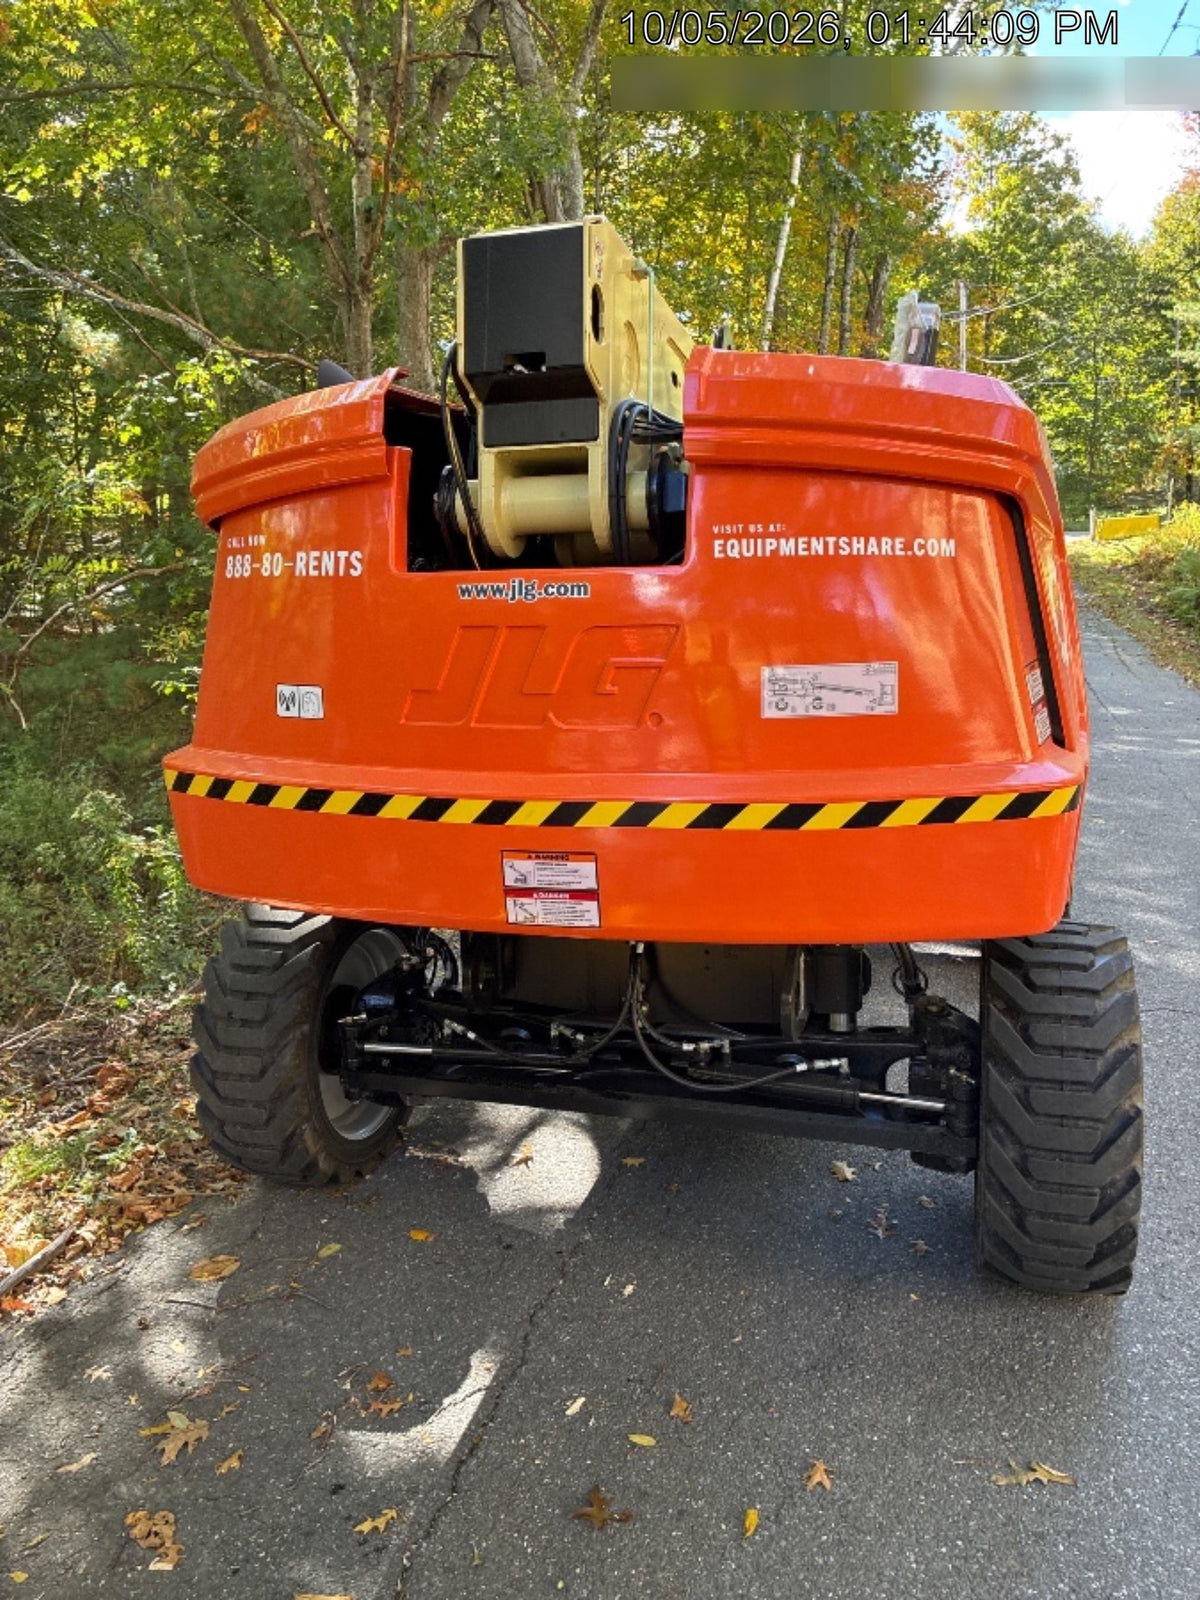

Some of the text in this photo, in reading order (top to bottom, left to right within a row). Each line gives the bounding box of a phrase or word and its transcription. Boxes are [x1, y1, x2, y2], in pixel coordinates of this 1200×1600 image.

[712, 523, 744, 534] VISIT
[748, 522, 764, 533] US
[713, 536, 956, 559] EQUIPMENTSHARE.COM
[225, 550, 364, 579] 888-80-RENTS
[457, 578, 590, 603] www.jlg.com
[399, 622, 681, 730] JLG
